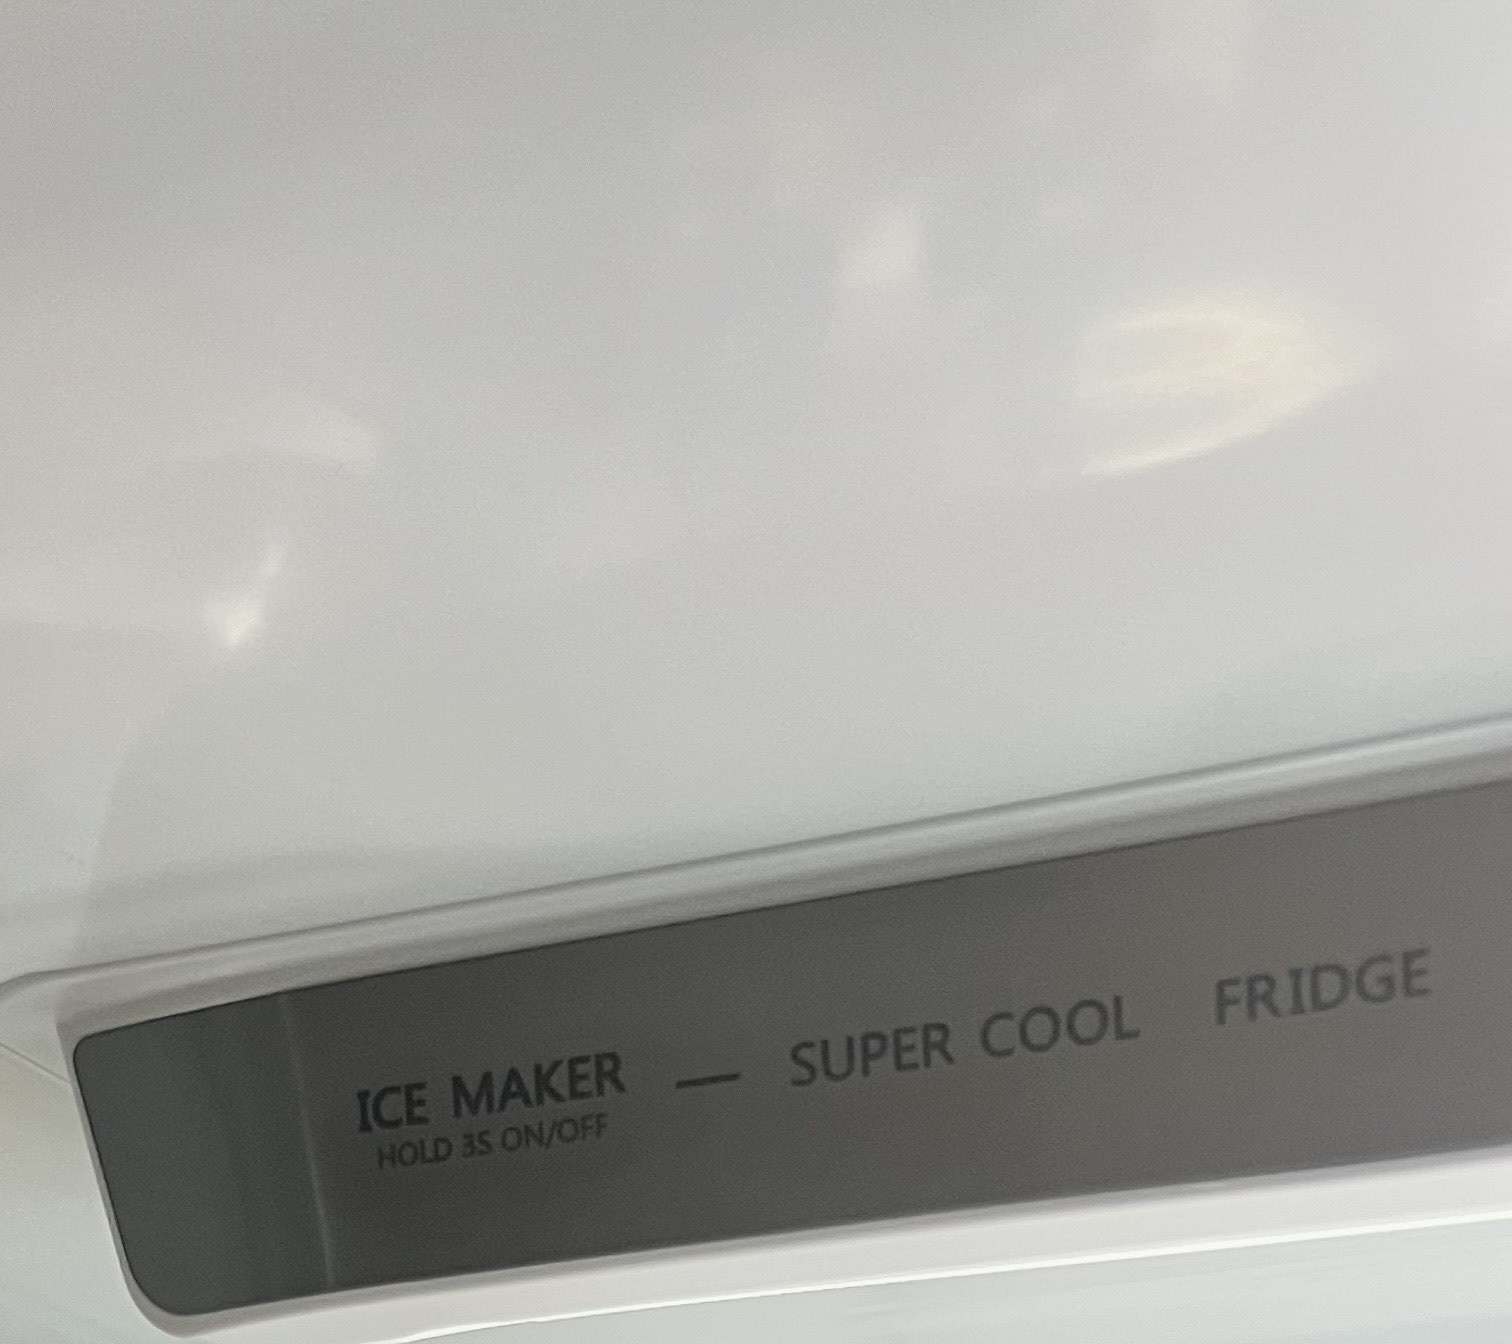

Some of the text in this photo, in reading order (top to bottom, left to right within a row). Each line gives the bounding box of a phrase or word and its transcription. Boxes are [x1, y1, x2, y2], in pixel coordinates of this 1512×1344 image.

[1215, 948, 1433, 1025] FRIDGE
[789, 996, 1141, 1087] SUPER COOL
[357, 1051, 627, 1134] ICE MAKER
[377, 1113, 608, 1169] HOLD 3S ON/OFF
